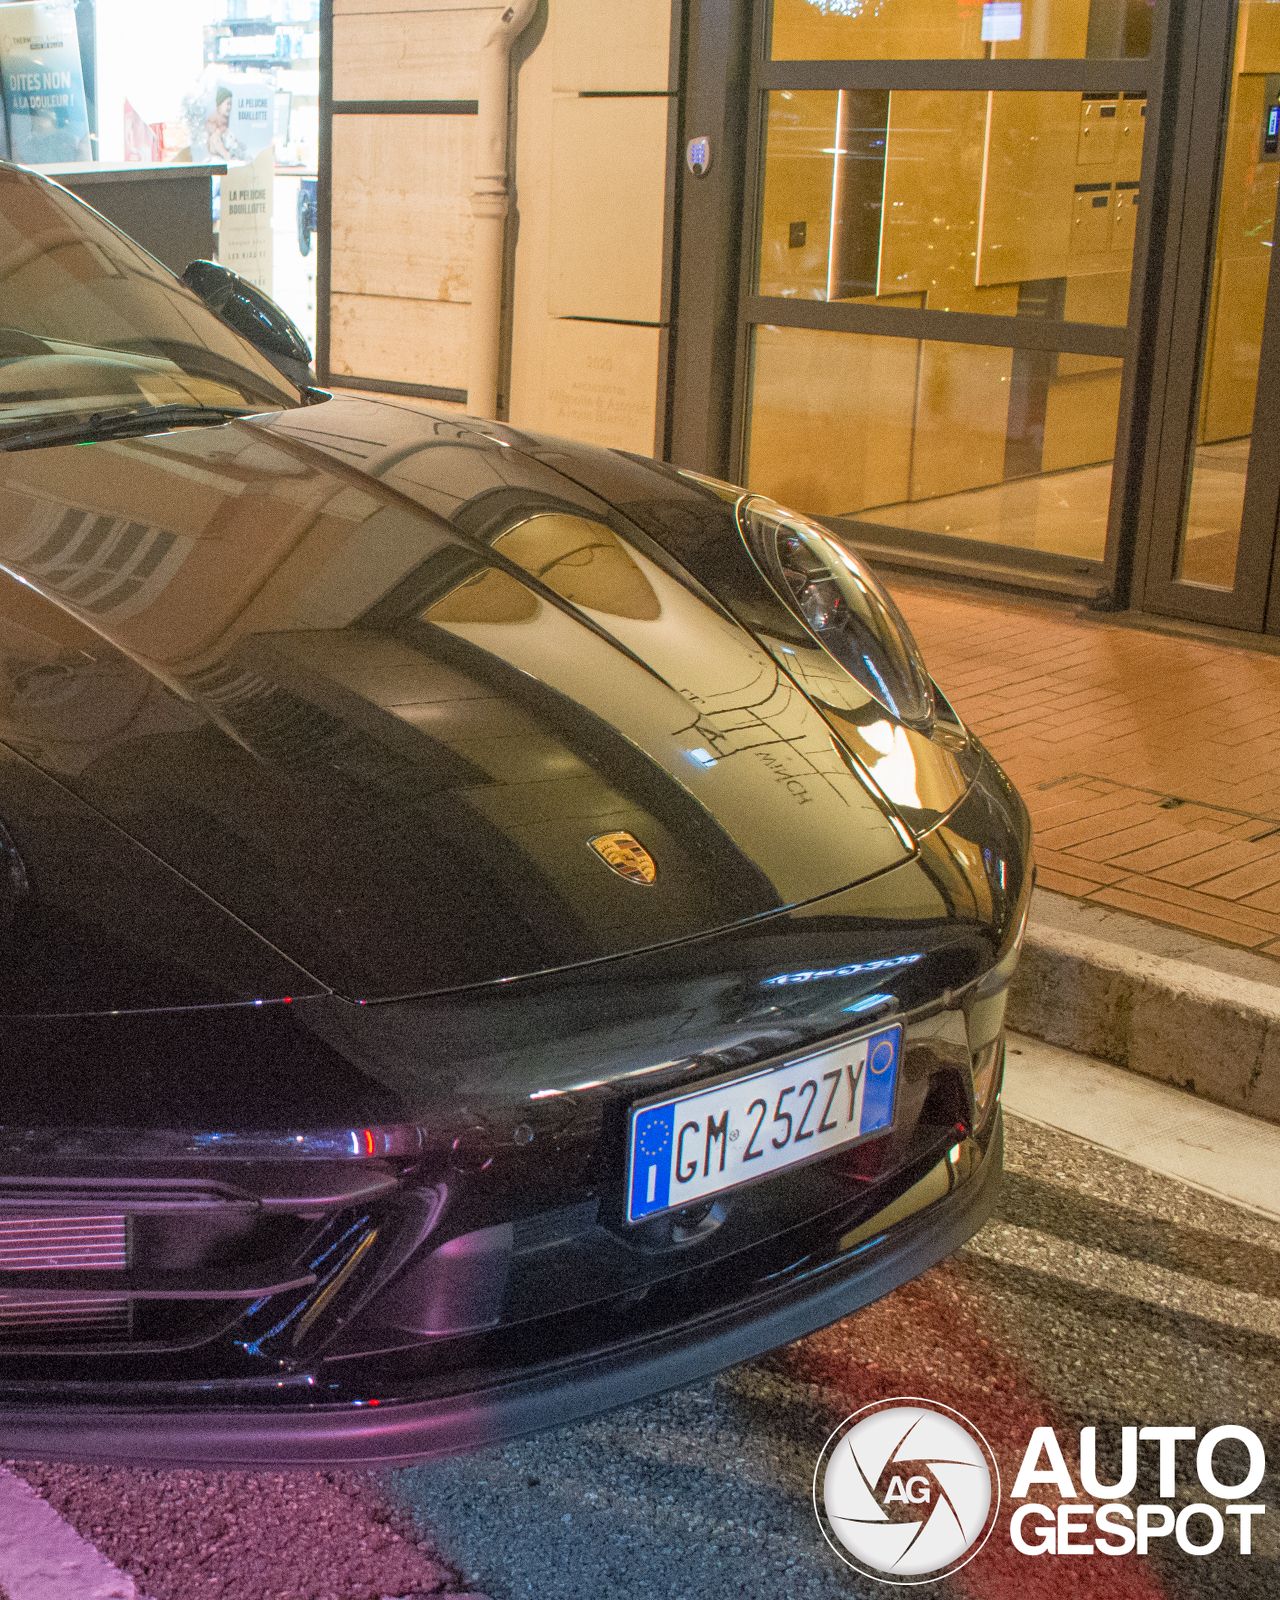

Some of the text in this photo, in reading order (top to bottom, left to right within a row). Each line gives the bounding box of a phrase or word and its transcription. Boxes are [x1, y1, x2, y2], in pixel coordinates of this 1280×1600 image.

[9, 70, 71, 91] DITES NON
[19, 95, 29, 109] LA
[30, 93, 69, 109] DOULEUR
[238, 98, 268, 108] LA PELUCHE
[238, 111, 268, 120] BOUILLOTTE
[229, 189, 266, 201] LA PELUCHE
[229, 202, 266, 215] BOUILLOTTE
[675, 1059, 865, 1184] GM 252ZY
